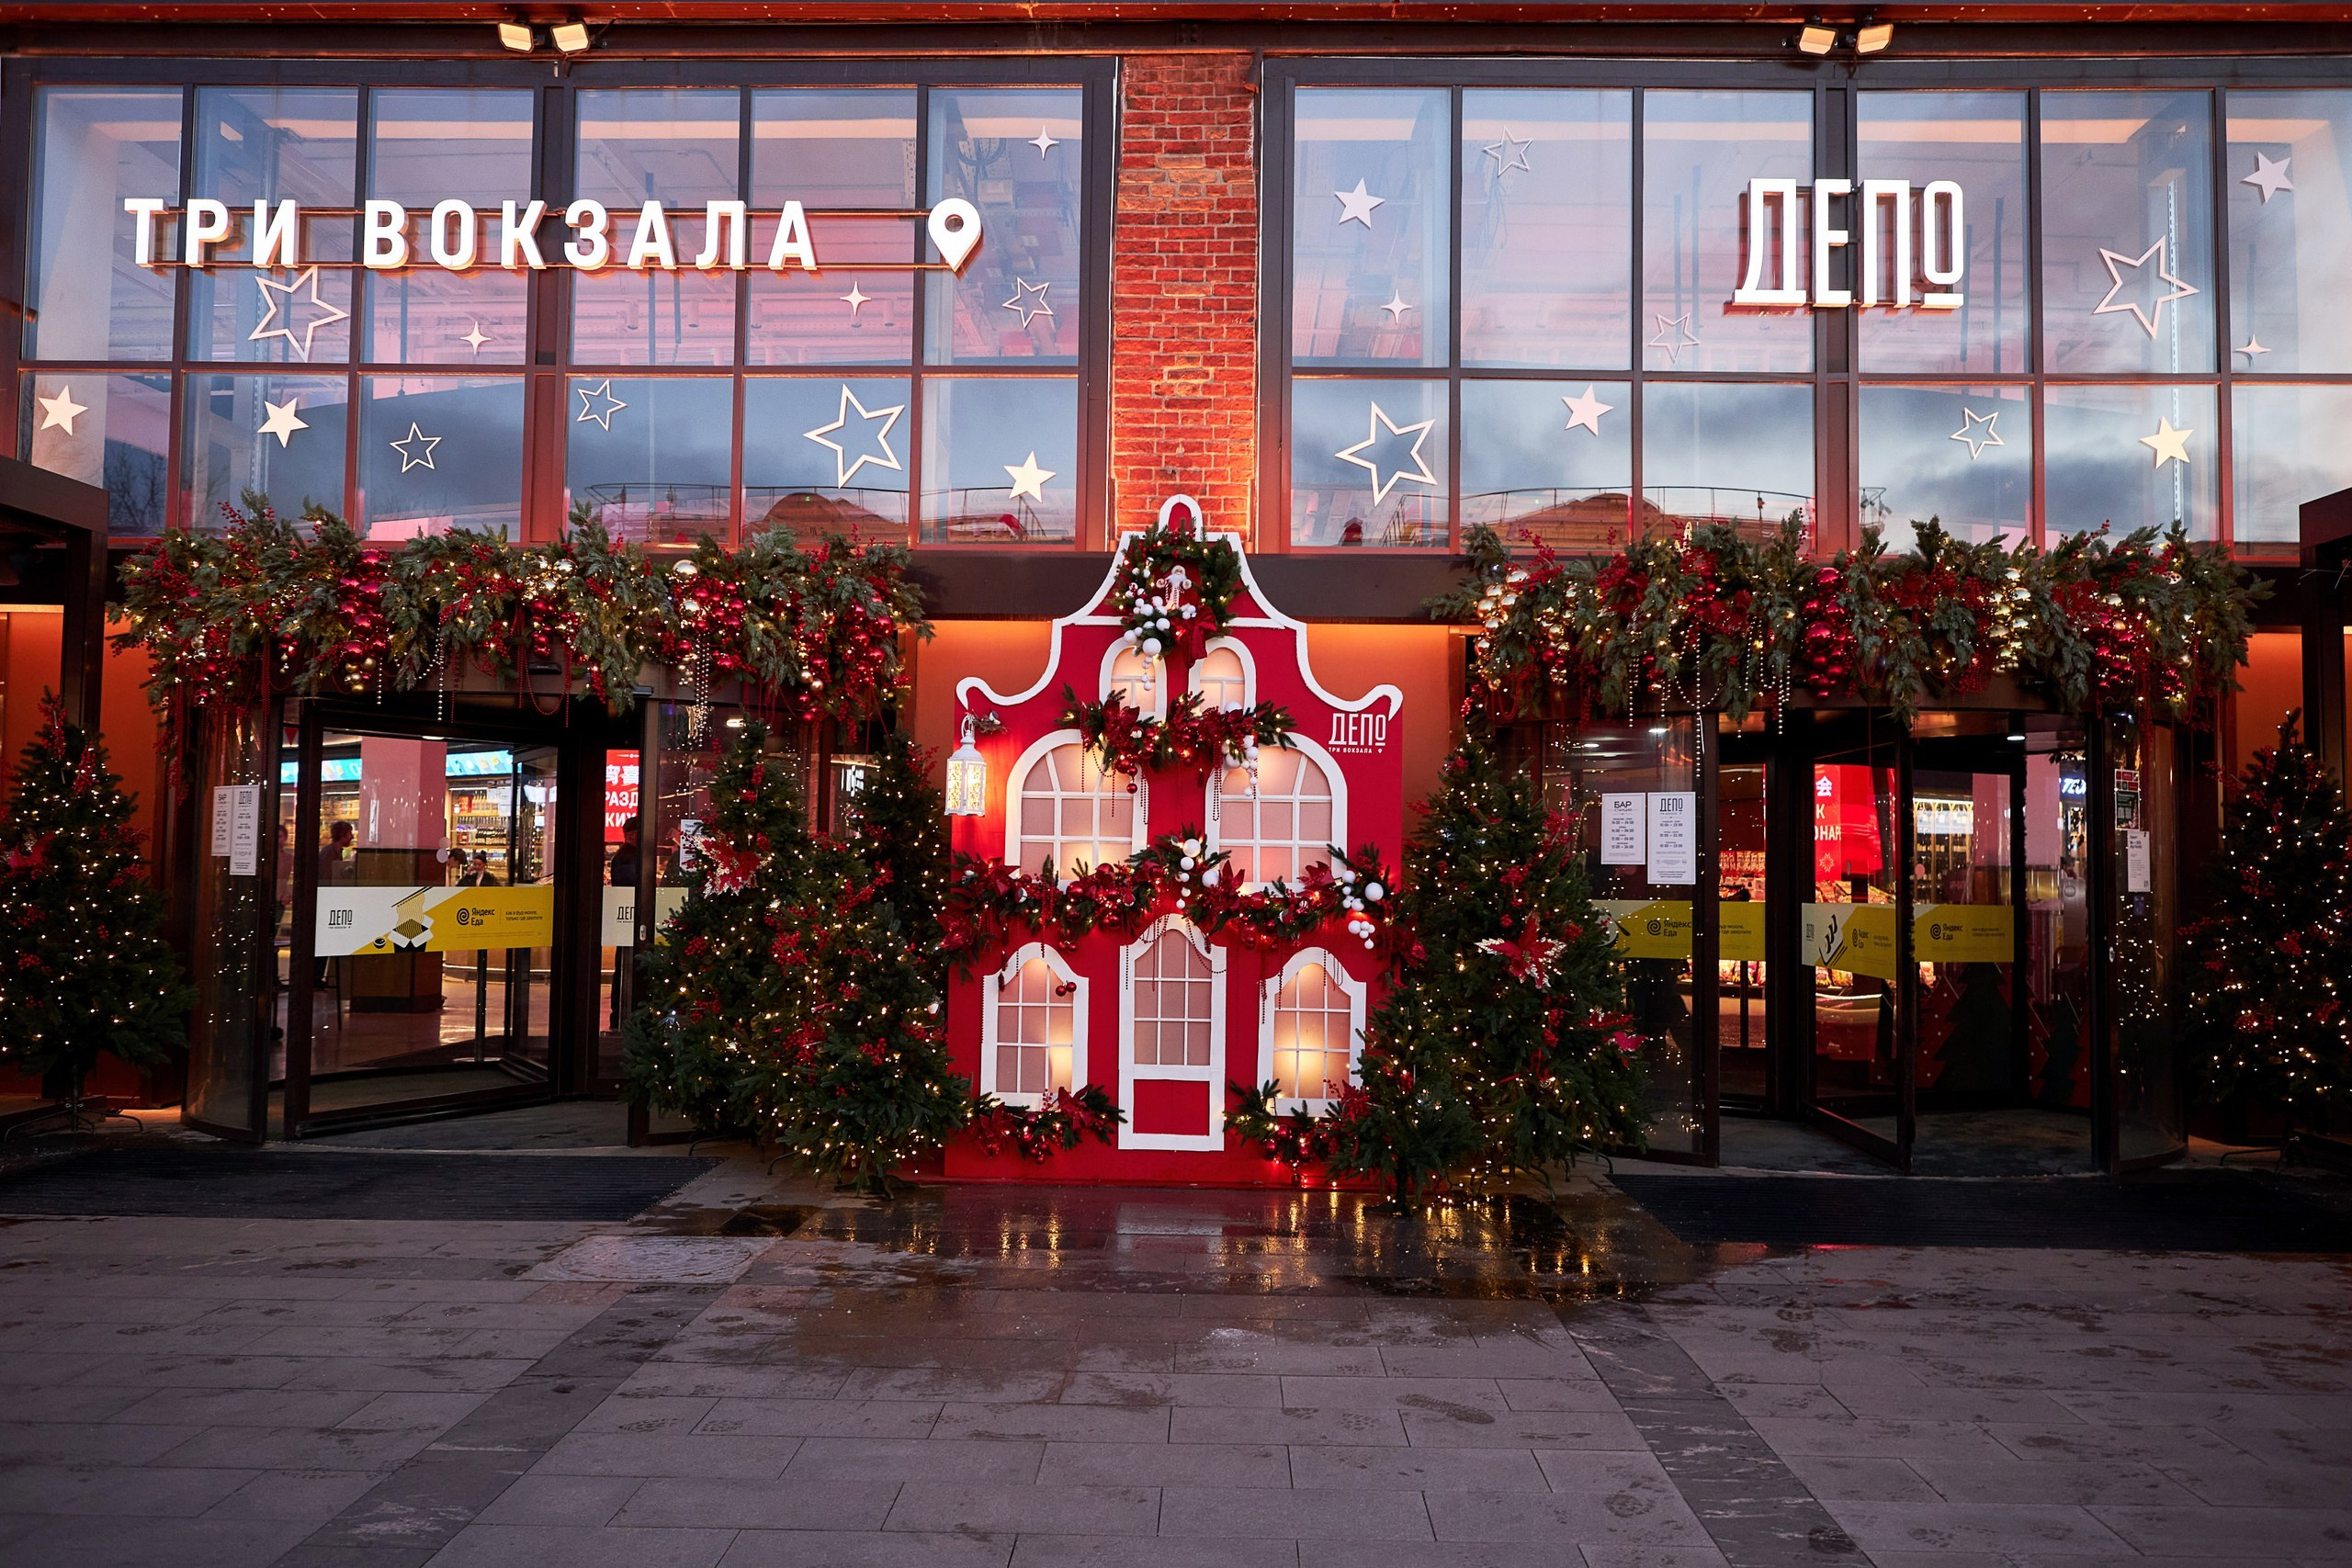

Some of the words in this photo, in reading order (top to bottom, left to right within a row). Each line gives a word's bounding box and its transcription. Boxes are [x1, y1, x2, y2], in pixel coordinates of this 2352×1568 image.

[124, 197, 299, 267] ТРИ
[363, 198, 817, 270] ВОКЗАЛА
[1733, 177, 1964, 308] ДЕПО
[1328, 713, 1386, 747] ДЕПО
[1659, 798, 1683, 812] ДЕПО
[328, 909, 353, 926] ДЕПО
[471, 908, 495, 917] Яндекс
[616, 907, 635, 920] ДЕП
[471, 918, 484, 927] Еда
[1663, 919, 1691, 929] Яндекс
[1942, 924, 1963, 932] Яндекс
[1663, 929, 1678, 937] Еда
